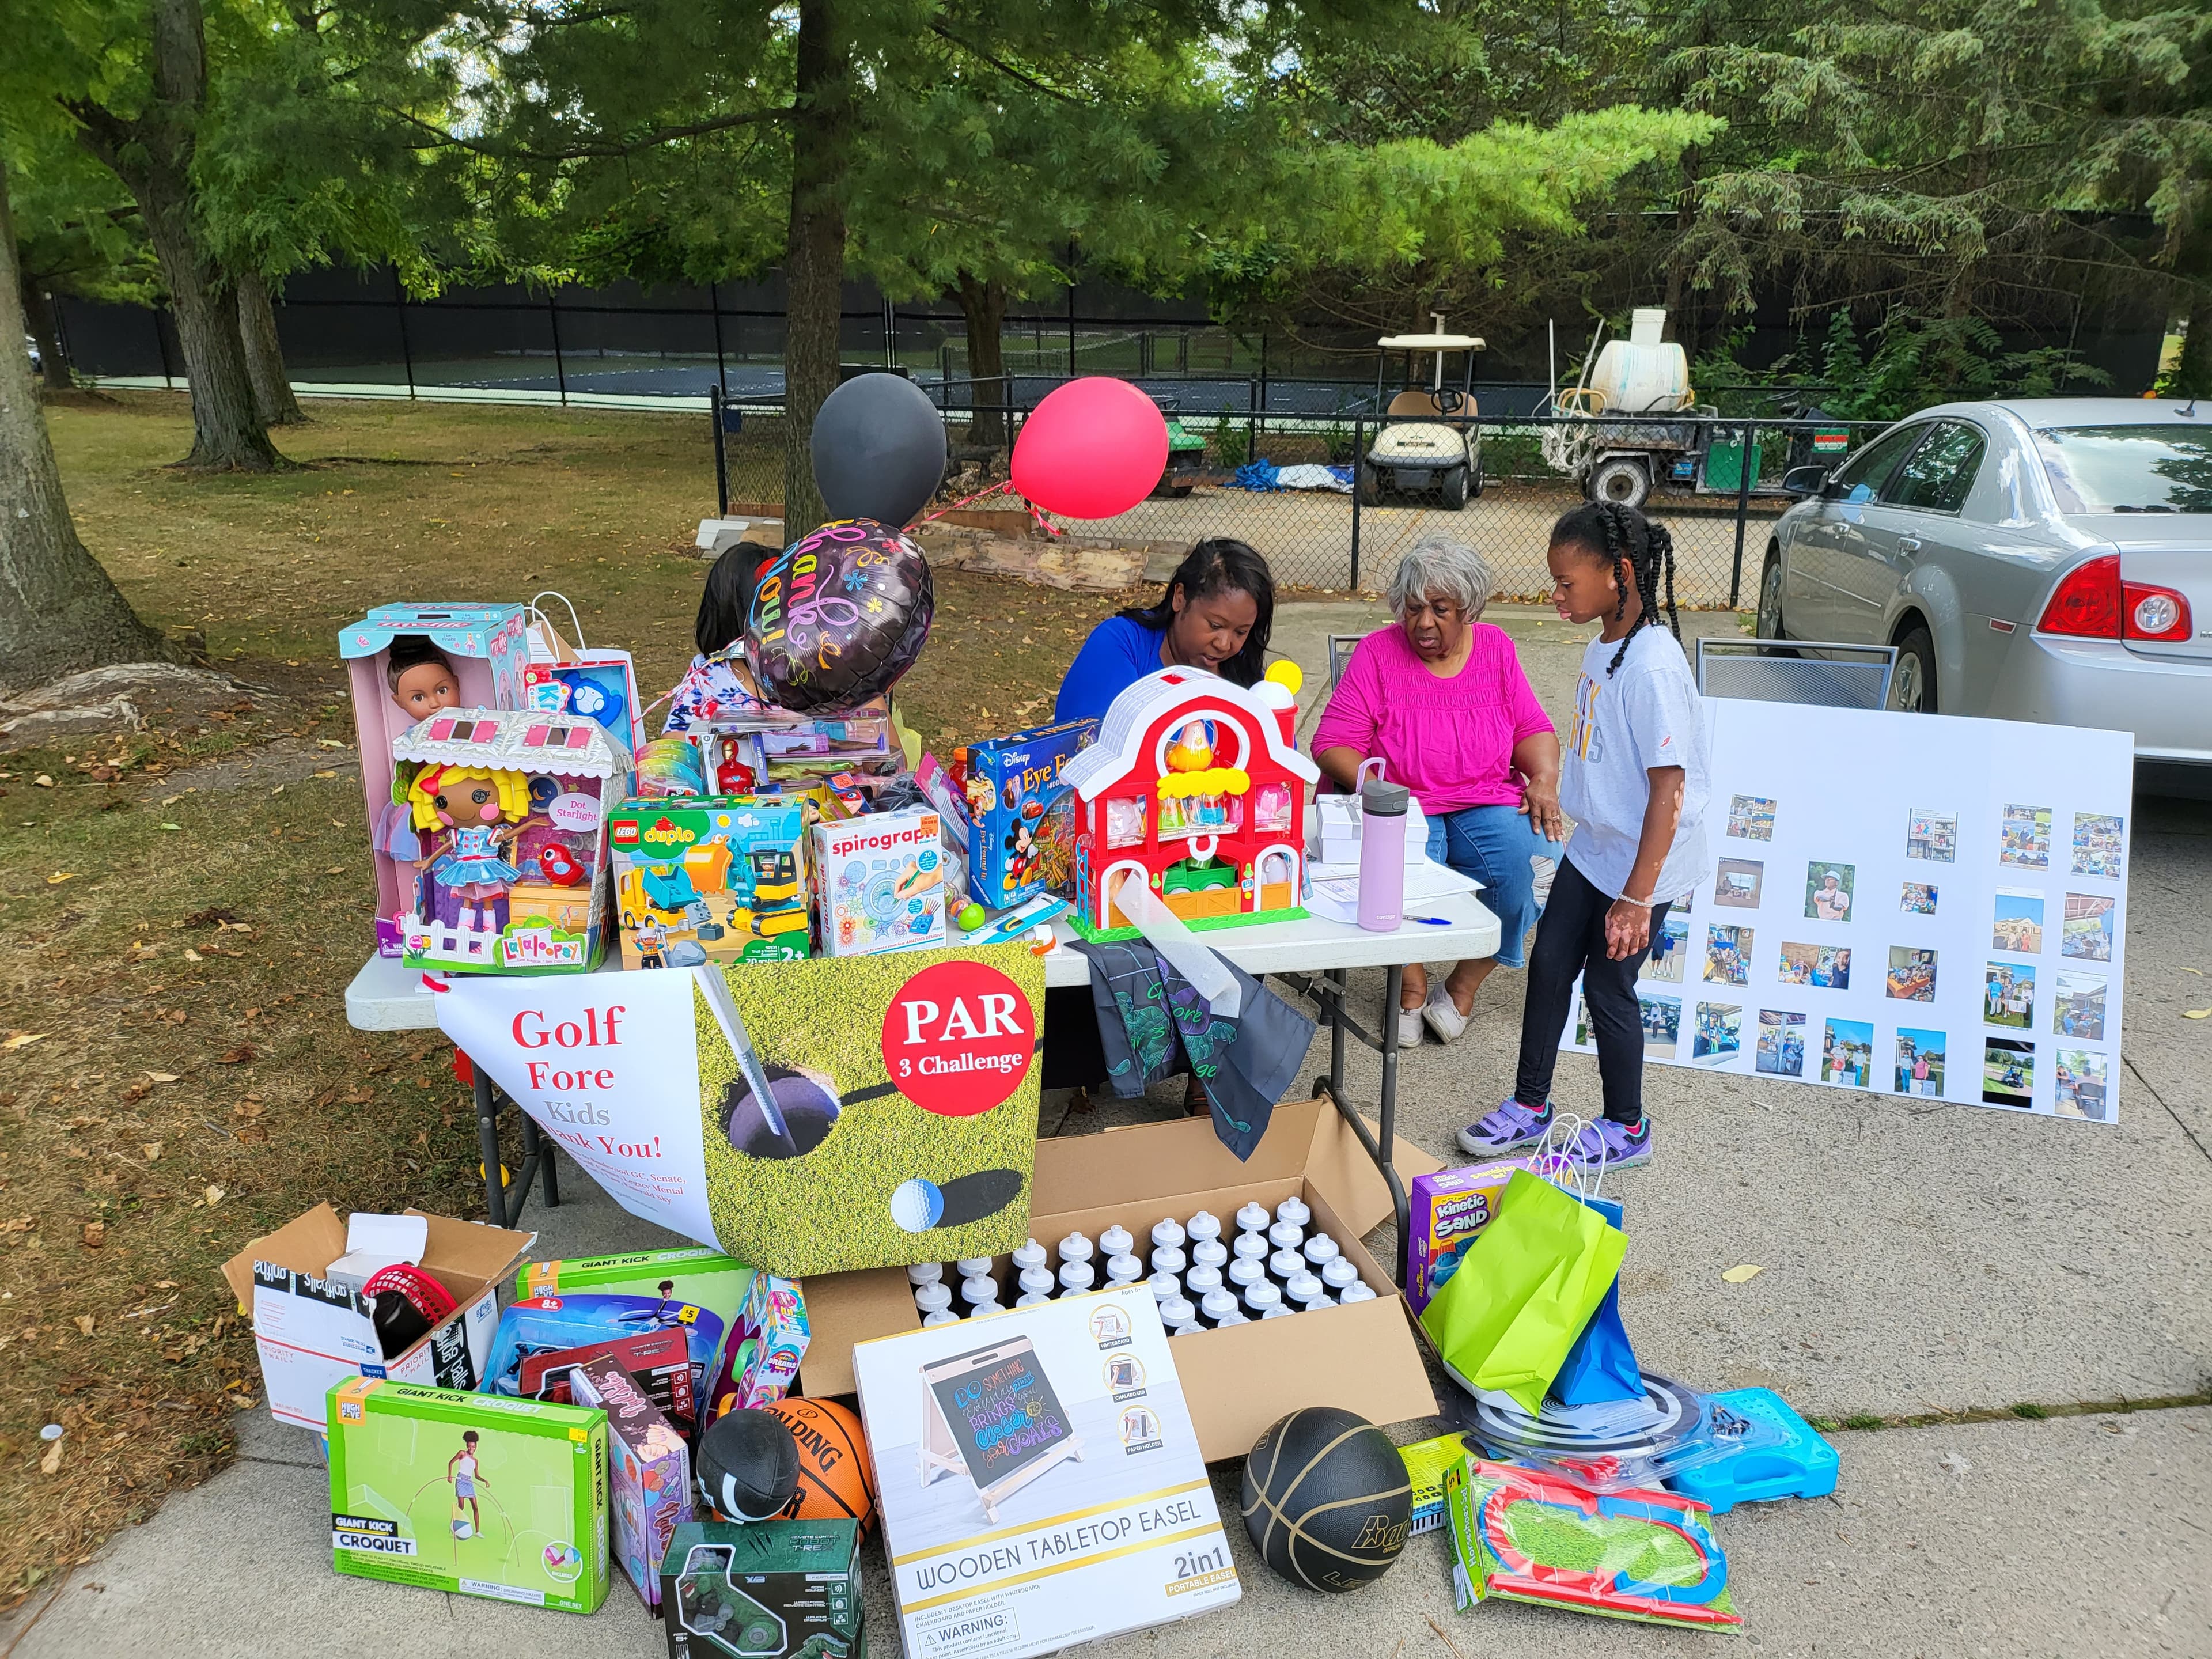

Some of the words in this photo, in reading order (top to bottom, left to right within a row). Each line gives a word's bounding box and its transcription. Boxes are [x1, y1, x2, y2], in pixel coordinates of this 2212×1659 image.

[1022, 764, 1051, 793] Eye
[556, 809, 597, 822] Starlight
[570, 800, 586, 809] Dot
[616, 827, 637, 837] LEGO
[643, 826, 695, 846] duplo
[820, 862, 831, 934] spirograph
[503, 935, 578, 961] Lalaloopsy
[781, 947, 805, 961] 2+
[512, 1005, 626, 1048] Golf
[900, 993, 1025, 1046] PAR
[524, 1061, 615, 1090] Fore
[898, 1058, 912, 1078] 3
[918, 1051, 1024, 1075] Challenge
[543, 1100, 611, 1126] Kids
[595, 1135, 662, 1159] You!
[631, 1171, 649, 1181] GC,
[650, 1173, 687, 1185] Senate,
[652, 1184, 684, 1195] Mental
[656, 1192, 671, 1205] Sky
[1436, 1194, 1485, 1219] Kinetic
[581, 1259, 618, 1268] GIANT
[621, 1256, 650, 1264] KICK
[657, 1248, 715, 1261] CROQUE
[685, 1309, 695, 1319] $5
[260, 1343, 295, 1358] PRIORITY
[1100, 1338, 1130, 1349] WHITEBOARD
[269, 1354, 289, 1363] MAIL
[400, 1345, 431, 1374] PRIORIT
[410, 1357, 429, 1374] MAIL
[363, 1367, 384, 1376] TRACKED
[954, 1380, 982, 1409] DO
[983, 1358, 1024, 1392] SOMETHING
[397, 1388, 435, 1398] GIANT
[436, 1393, 468, 1403] KICK
[472, 1396, 544, 1414] CROQUET
[1115, 1389, 1146, 1401] CHALKBOARD
[969, 1396, 1016, 1433] BRINGS
[764, 1407, 844, 1474] ALDING
[1006, 1414, 1063, 1456] GOALS
[1127, 1444, 1142, 1453] PAPER
[1142, 1441, 1162, 1450] HOLDER
[1460, 1488, 1468, 1505] Set
[335, 1516, 367, 1529] GIANT
[368, 1521, 393, 1532] KICK
[1462, 1505, 1477, 1567] Horseshoes
[340, 1534, 411, 1554] CROQUET
[596, 1514, 605, 1584] CROQUET
[916, 1544, 1022, 1591] WOODEN
[1027, 1517, 1132, 1561] TABLETOP
[1139, 1500, 1202, 1532] EASEL
[1174, 1546, 1225, 1580] 2in1
[1168, 1576, 1210, 1594] PORTABLE
[1210, 1570, 1236, 1582] EASEL
[914, 1609, 944, 1622] INCLUDES:
[948, 1601, 973, 1613] DESKTOP
[974, 1597, 991, 1607] EASEL
[991, 1593, 1005, 1602] WITH
[1005, 1584, 1041, 1598] WHITEBOARD,
[915, 1616, 953, 1629] CHALKBOARD
[953, 1611, 965, 1619] AND
[966, 1606, 983, 1616] PAPER
[938, 1615, 1009, 1642] WARNING:
[931, 1645, 943, 1653] This
[943, 1640, 962, 1652] product
[962, 1634, 983, 1645] contains
[983, 1627, 1007, 1639] functional
[938, 1649, 953, 1658] point.
[953, 1641, 979, 1656] Assembled
[979, 1641, 987, 1649] by
[993, 1636, 1006, 1645] adult
[1006, 1633, 1019, 1643] only.
